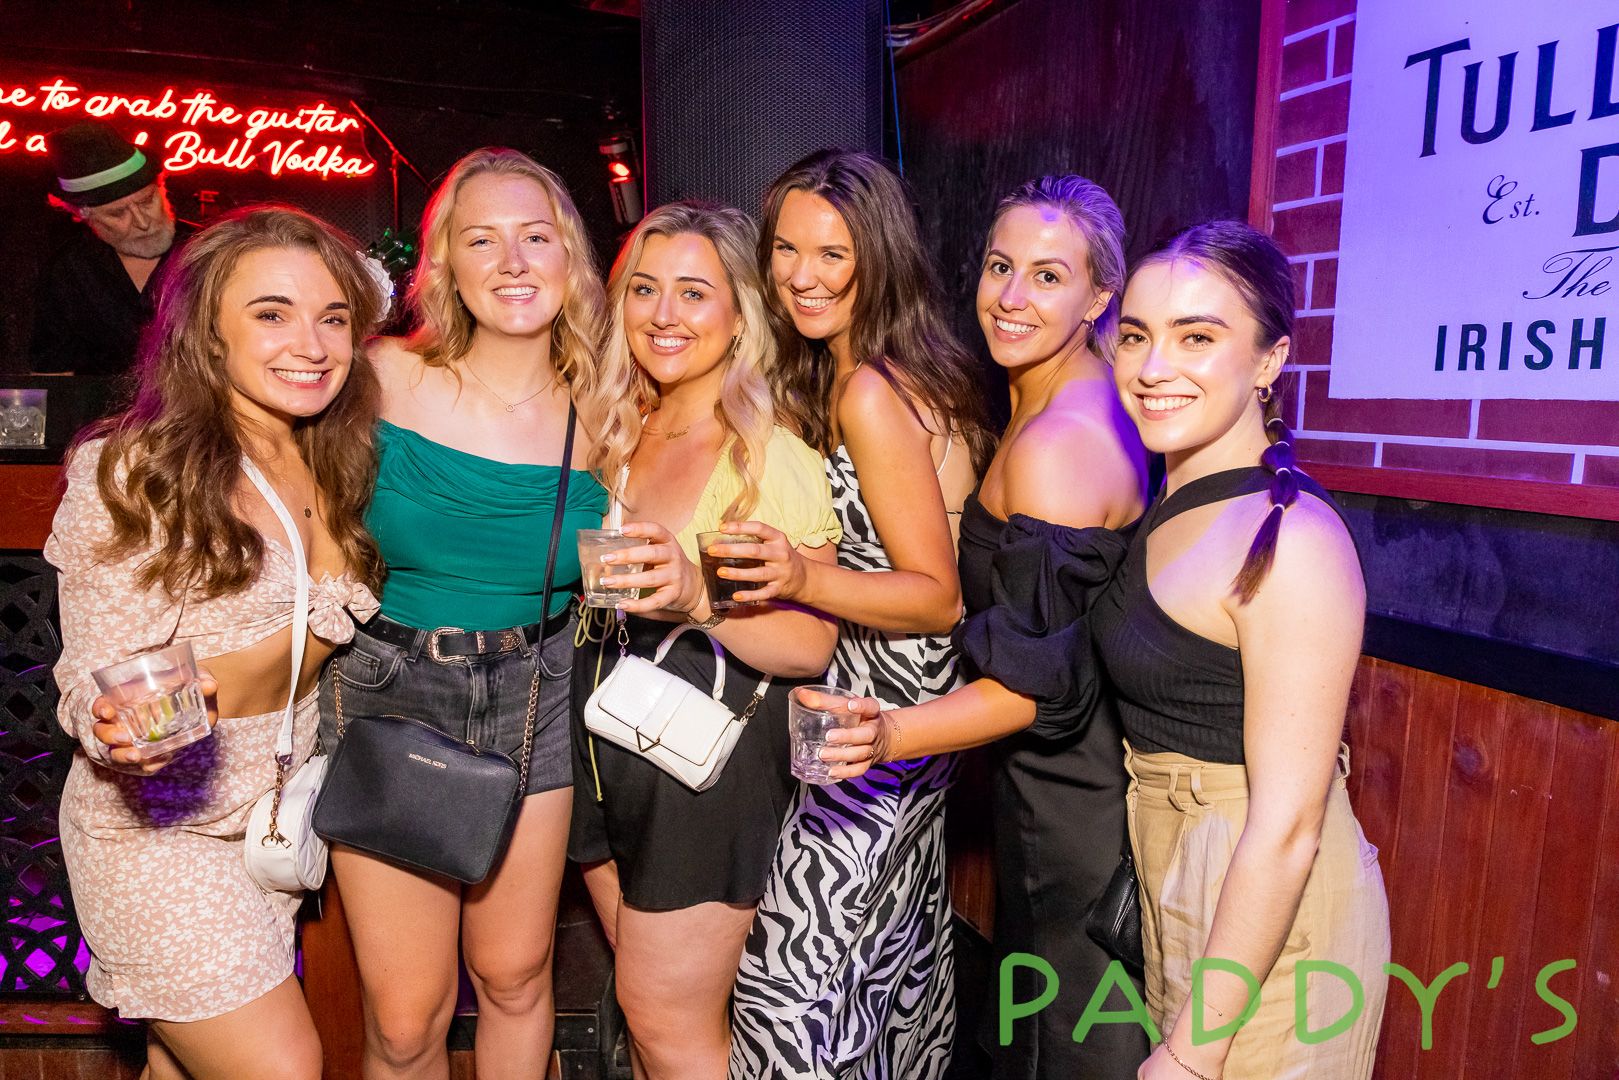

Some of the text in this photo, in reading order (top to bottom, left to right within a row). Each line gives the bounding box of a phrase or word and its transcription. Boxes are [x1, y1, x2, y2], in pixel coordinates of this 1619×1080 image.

[40, 79, 81, 112] to
[181, 92, 243, 126] the
[246, 103, 360, 139] guitar
[164, 130, 256, 171] Bull
[262, 139, 375, 176] Vodka
[1482, 174, 1540, 225] Est.
[1522, 246, 1619, 300] The
[1434, 317, 1607, 372] IRISH
